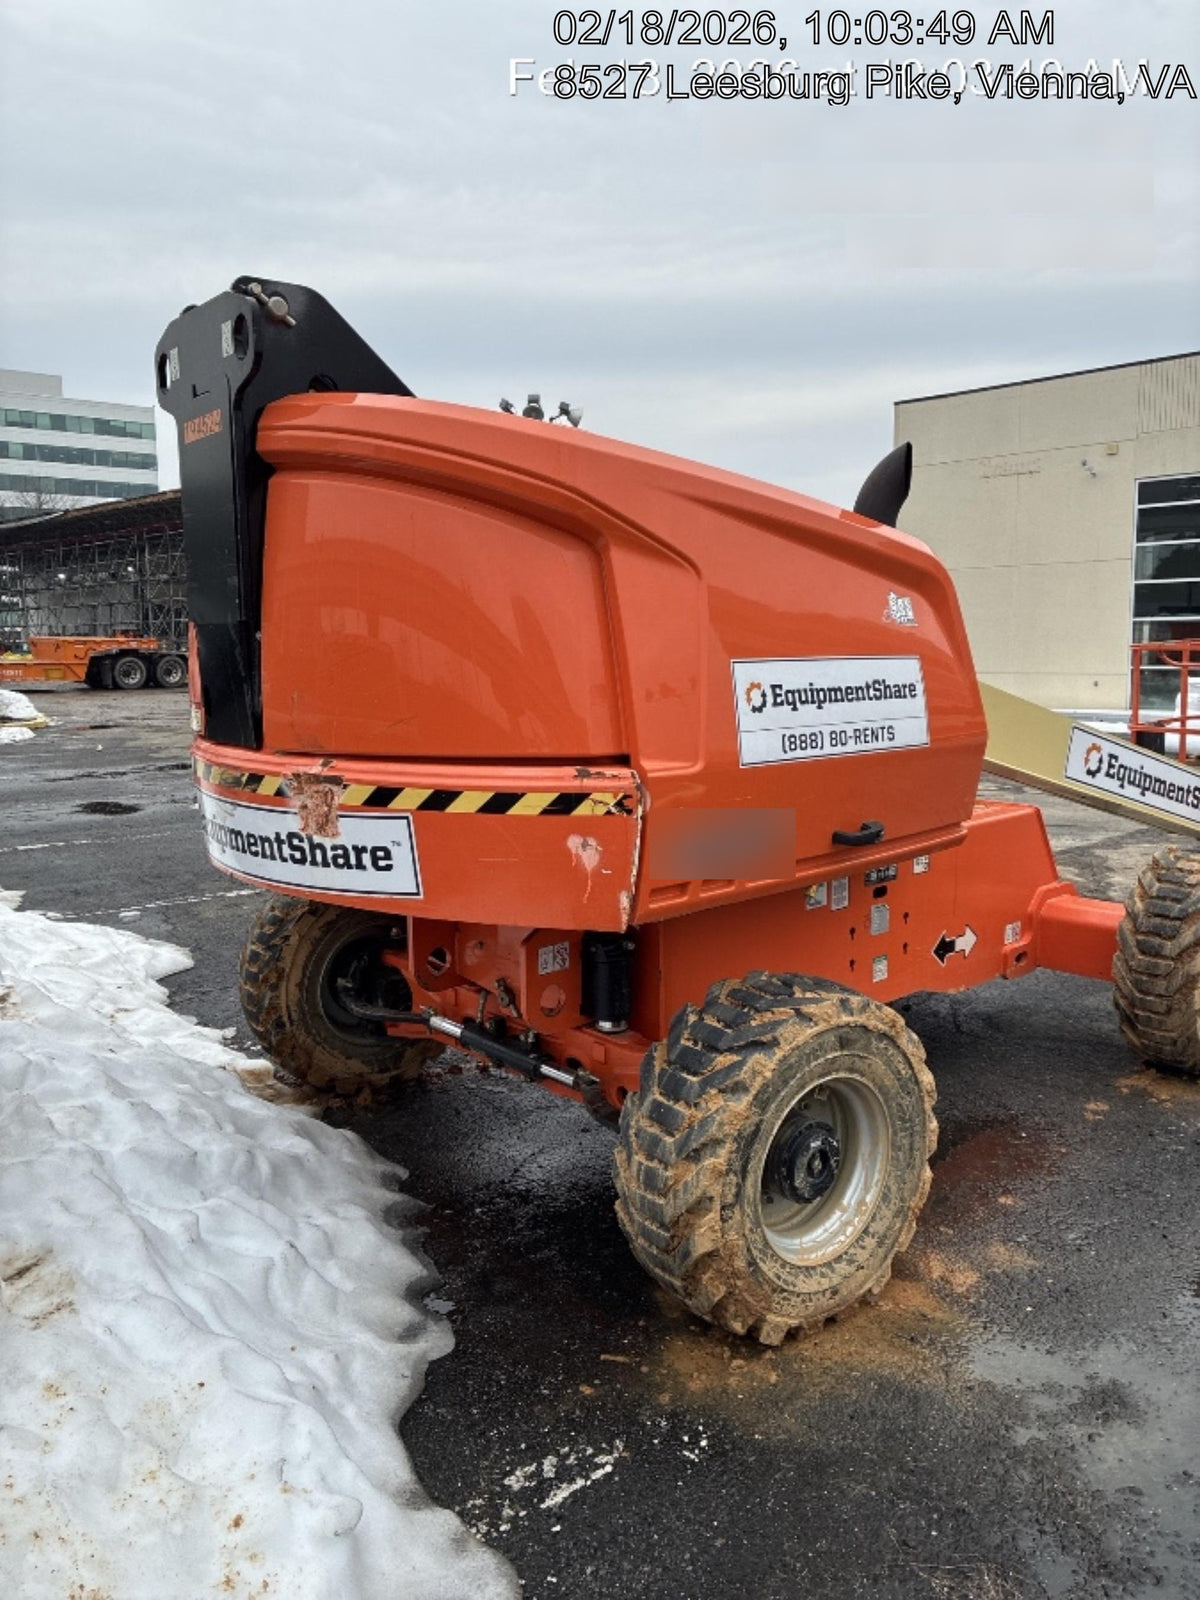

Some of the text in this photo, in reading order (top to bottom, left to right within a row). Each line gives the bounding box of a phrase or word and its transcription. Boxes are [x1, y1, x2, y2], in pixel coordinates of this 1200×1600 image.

[769, 679, 918, 712] EquipmentShare
[781, 725, 896, 754] (888) 80-RENTS
